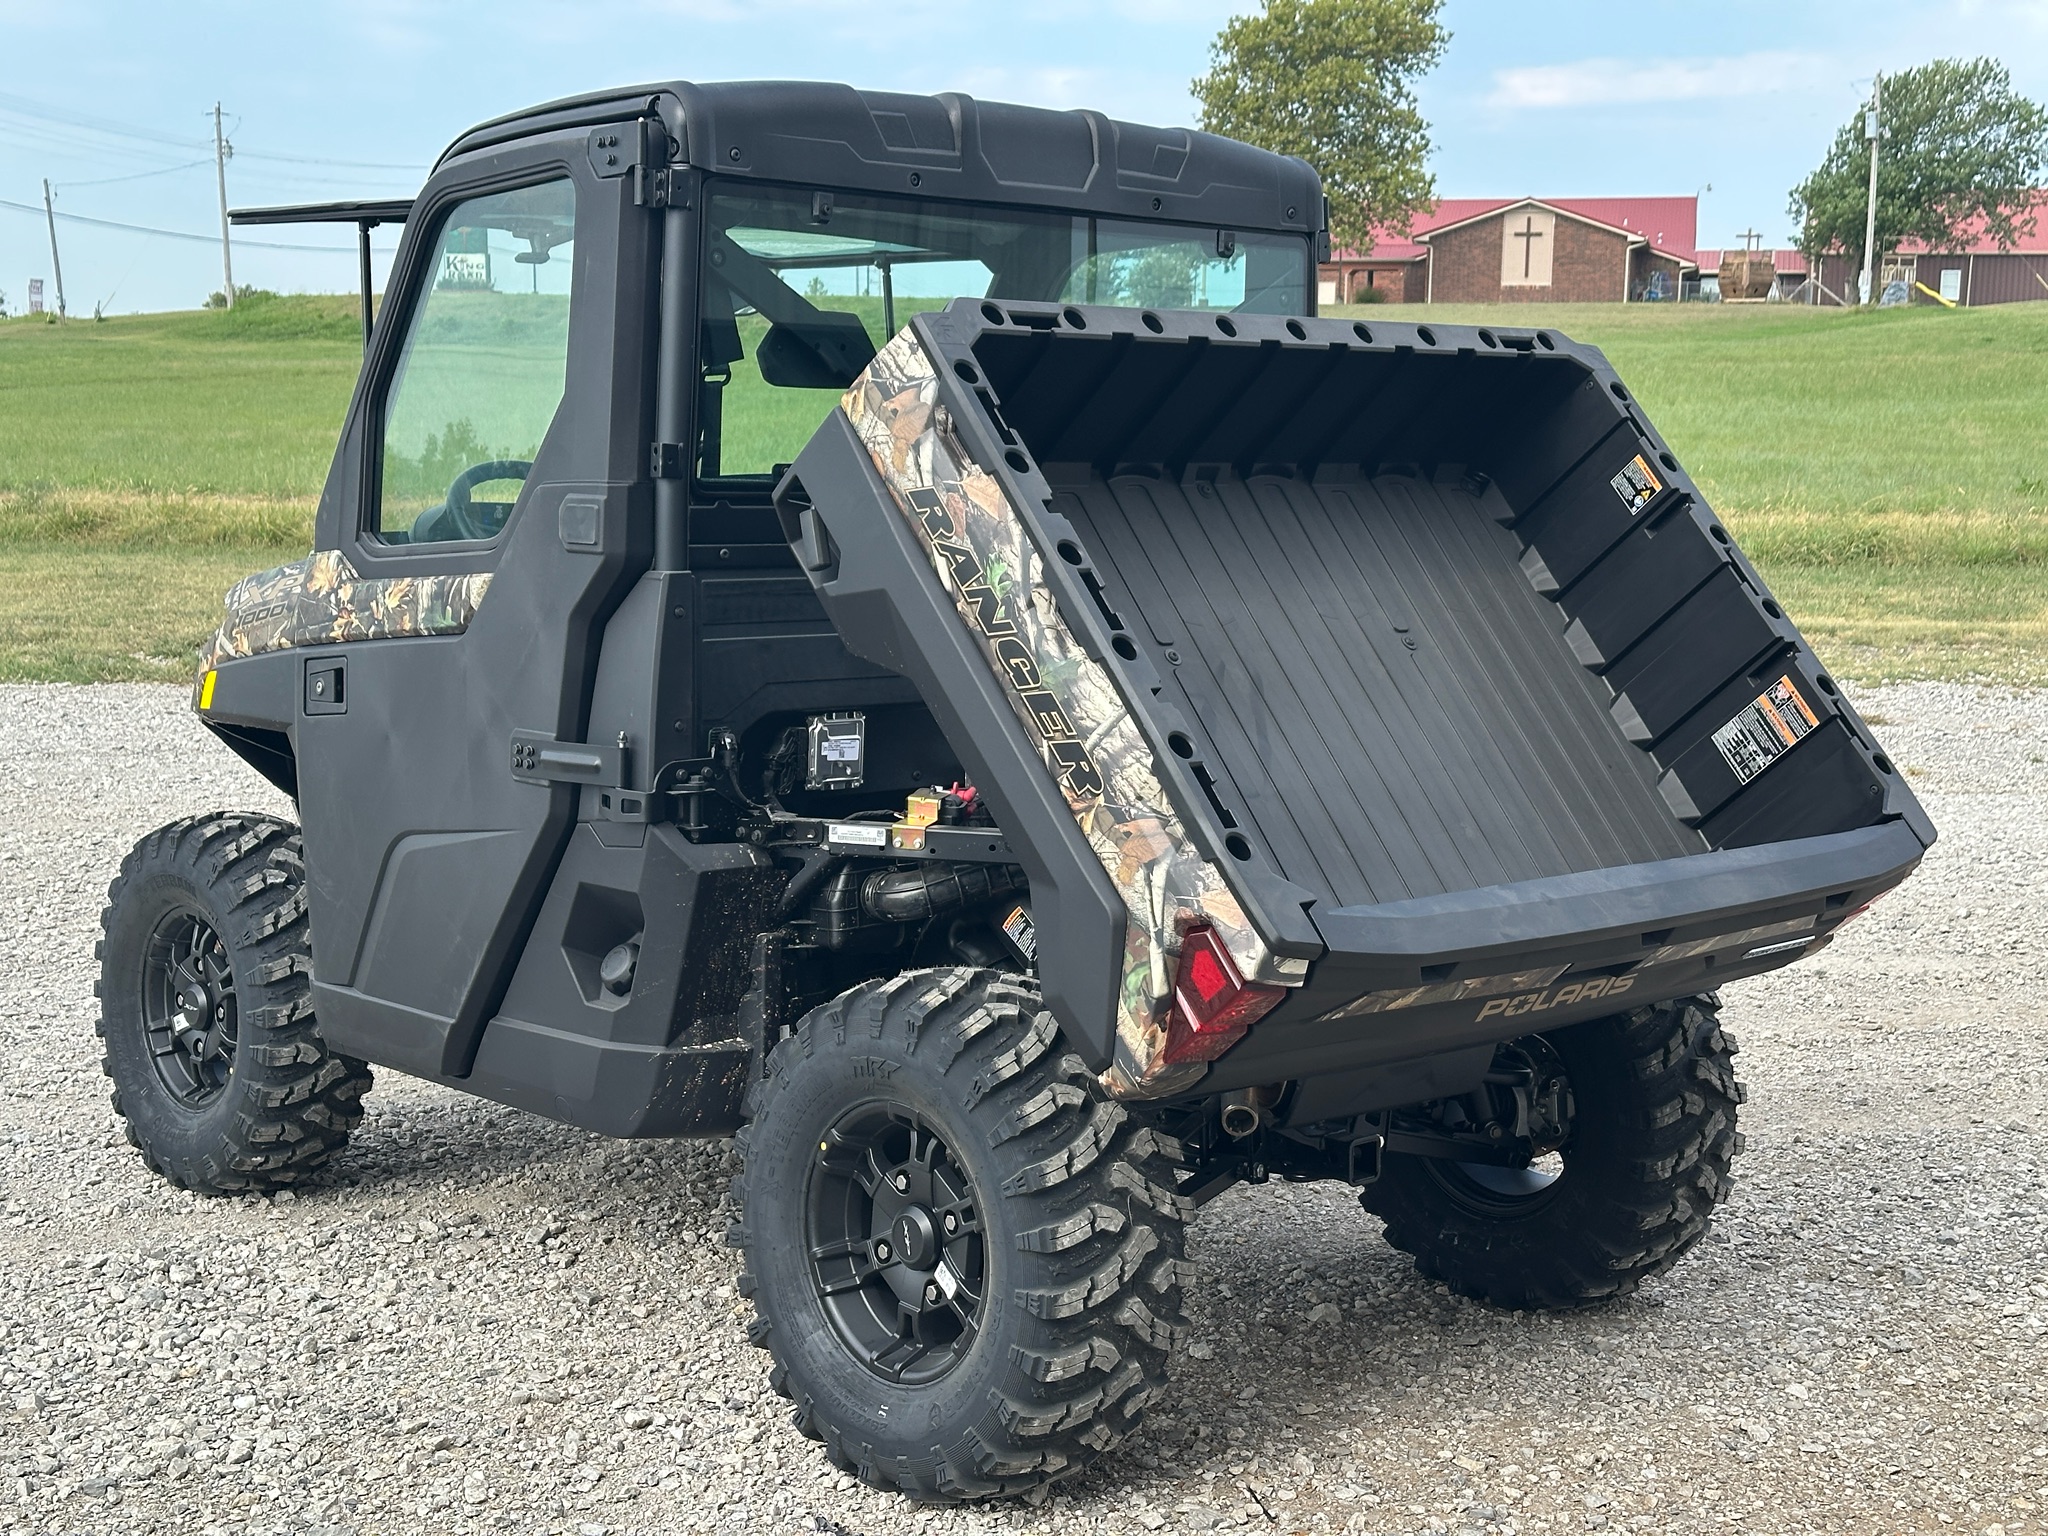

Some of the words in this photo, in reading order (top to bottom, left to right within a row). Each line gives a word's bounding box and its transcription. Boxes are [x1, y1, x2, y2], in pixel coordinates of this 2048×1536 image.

[237, 573, 305, 611] XP
[237, 601, 288, 627] 1000
[905, 486, 1105, 797] RANGER
[1474, 973, 1639, 1023] POLARIS
